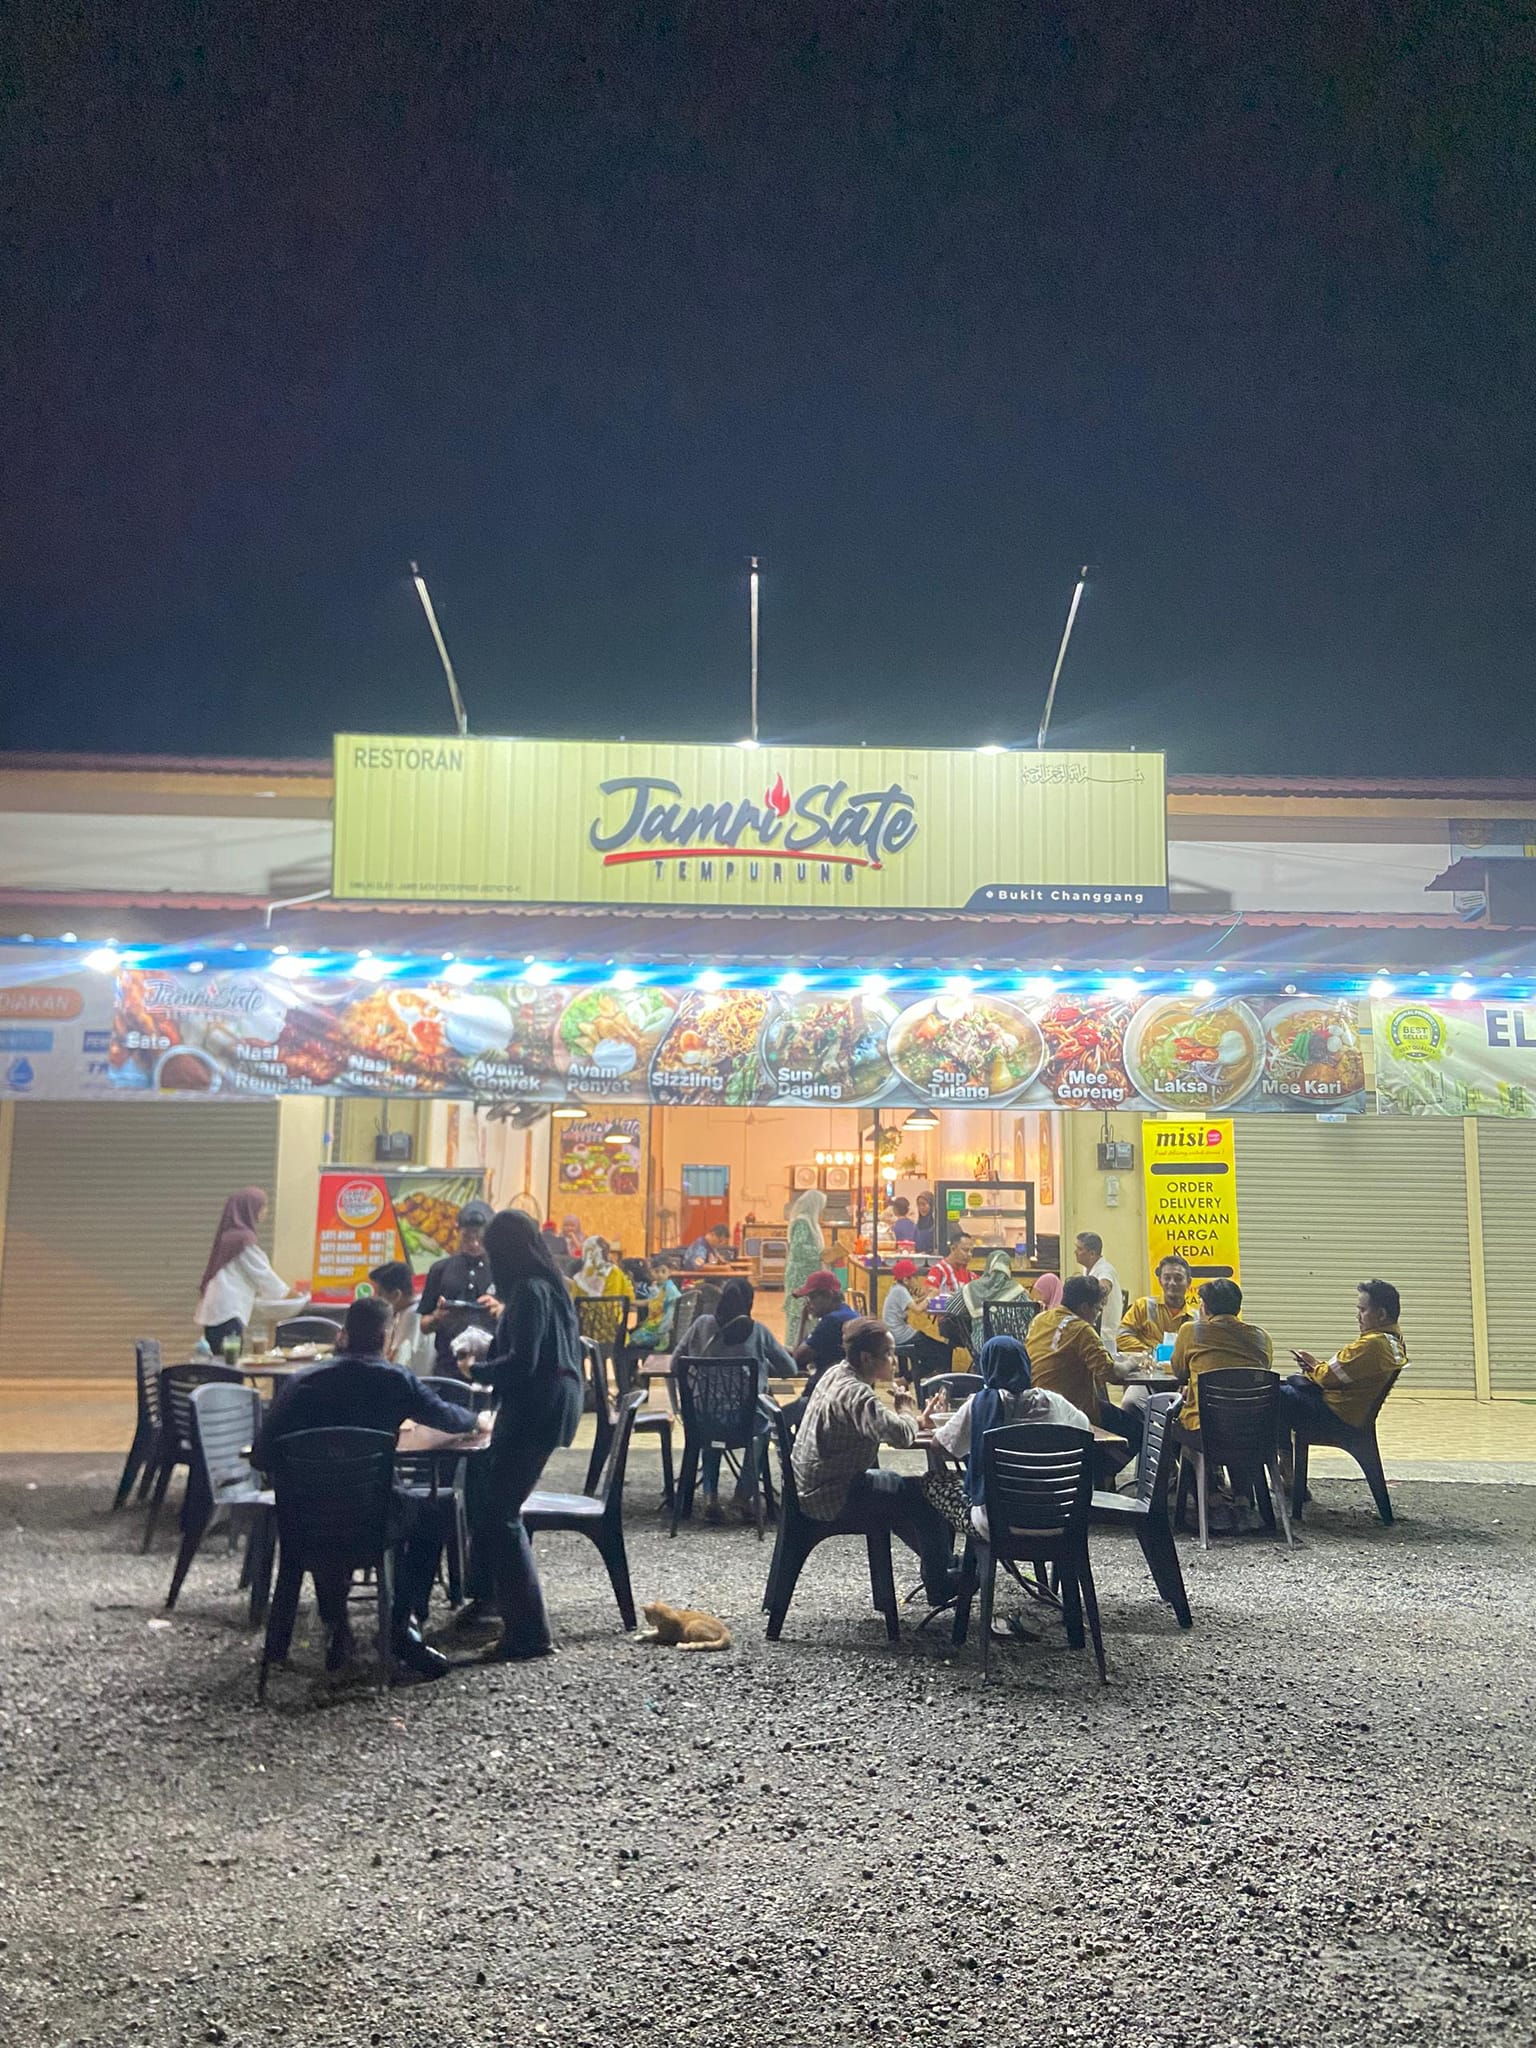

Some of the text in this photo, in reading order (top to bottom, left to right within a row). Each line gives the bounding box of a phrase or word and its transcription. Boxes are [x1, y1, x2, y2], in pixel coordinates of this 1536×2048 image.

[354, 748, 463, 772] RESTORAN
[590, 776, 783, 851] Jamri
[784, 779, 918, 863] Sate
[655, 860, 854, 882] TEMPURUNG
[999, 890, 1144, 903] Bukit Changgang
[1403, 1026, 1428, 1034] BEST
[126, 1031, 171, 1050] Sate
[236, 1045, 279, 1062] Nasi
[349, 1055, 392, 1073] Nasi
[473, 1060, 525, 1080] Ayam
[567, 1063, 617, 1080] Ayam
[651, 1071, 724, 1091] Sizzling
[777, 1067, 813, 1085] Sup
[932, 1069, 968, 1086] Sup
[1068, 1070, 1108, 1085] Mee
[567, 1078, 631, 1096] Penyet
[777, 1082, 843, 1099] Daging
[928, 1083, 990, 1100] Tulang
[1057, 1086, 1125, 1102] Goreng
[1153, 1078, 1208, 1095] Laksa
[1261, 1080, 1342, 1095] Mee Kari
[1156, 1127, 1205, 1147] misi
[1166, 1182, 1214, 1193] ORDER
[1159, 1198, 1222, 1209] DELIVERY
[1153, 1213, 1230, 1225] MAKANAN
[1166, 1229, 1219, 1241] HARGA
[1172, 1245, 1214, 1257] KEDAI
